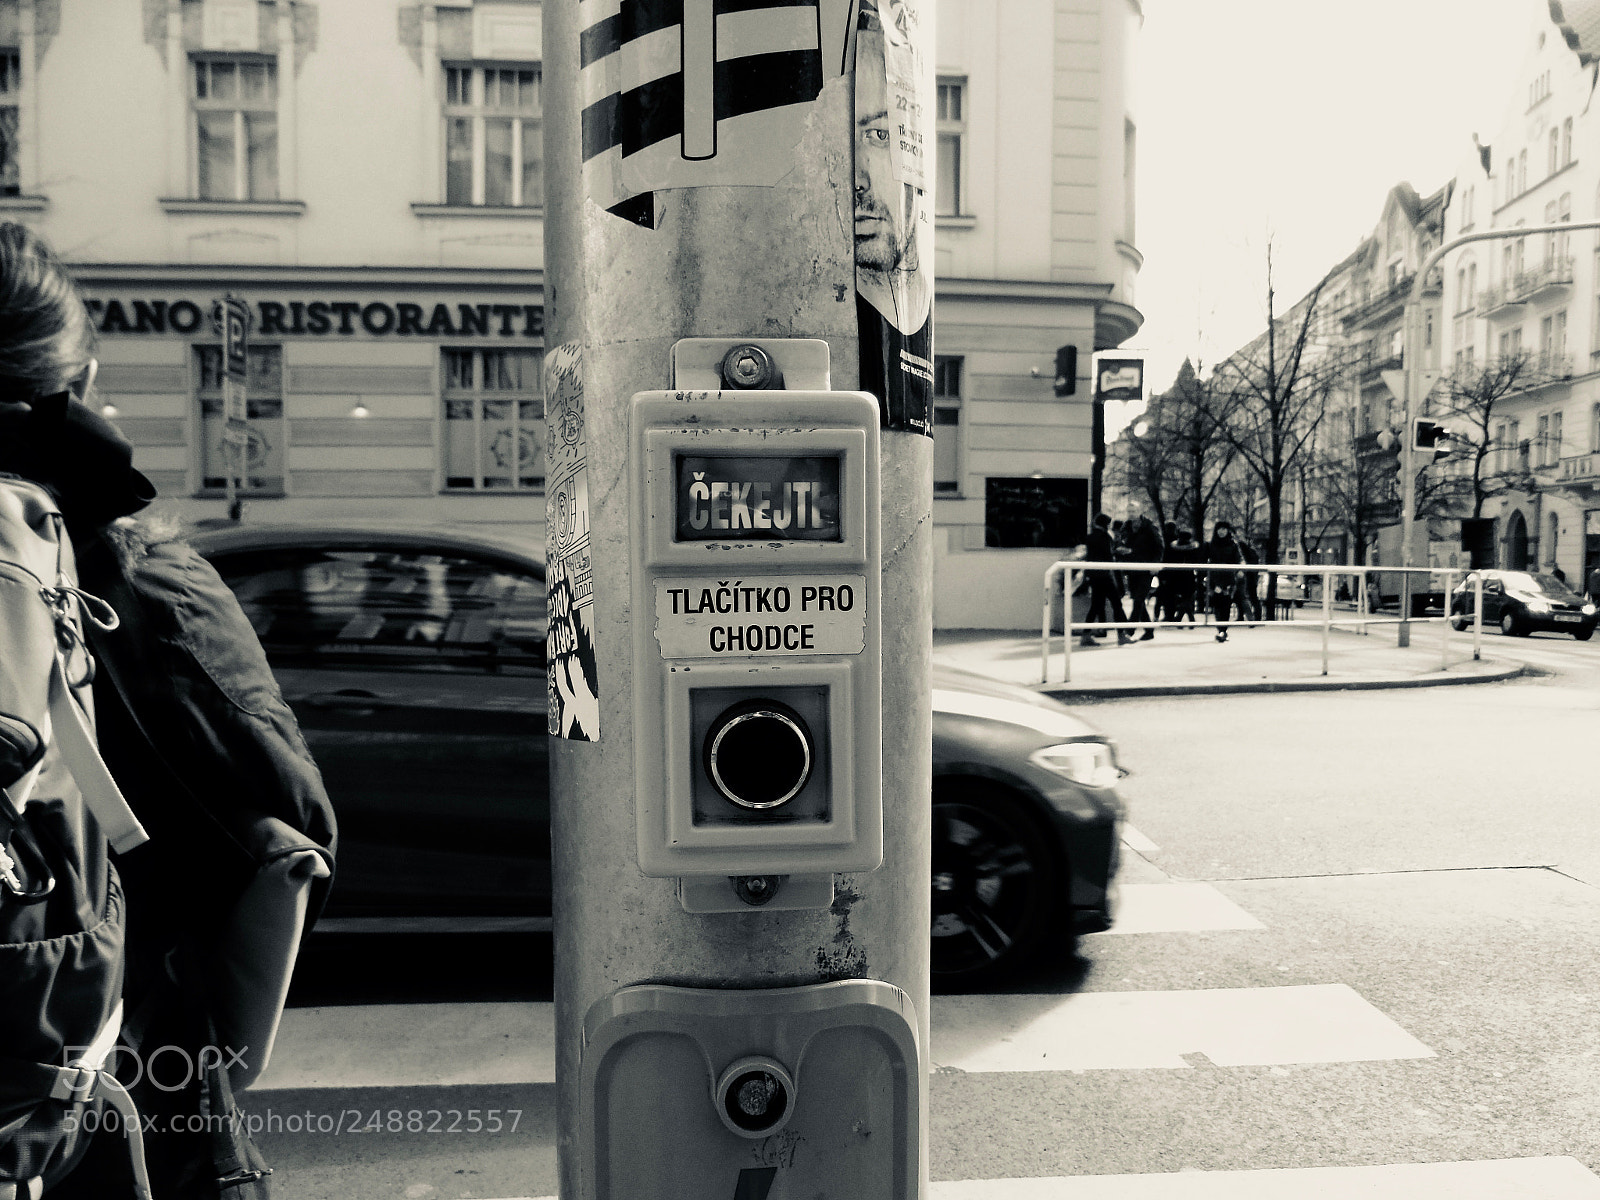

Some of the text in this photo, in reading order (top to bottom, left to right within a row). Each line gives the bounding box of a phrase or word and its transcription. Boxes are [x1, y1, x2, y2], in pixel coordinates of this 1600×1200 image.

[257, 301, 545, 337] RISTORANTE
[666, 580, 854, 615] TLAČÍTKO PRO
[709, 624, 815, 652] CHODCE
